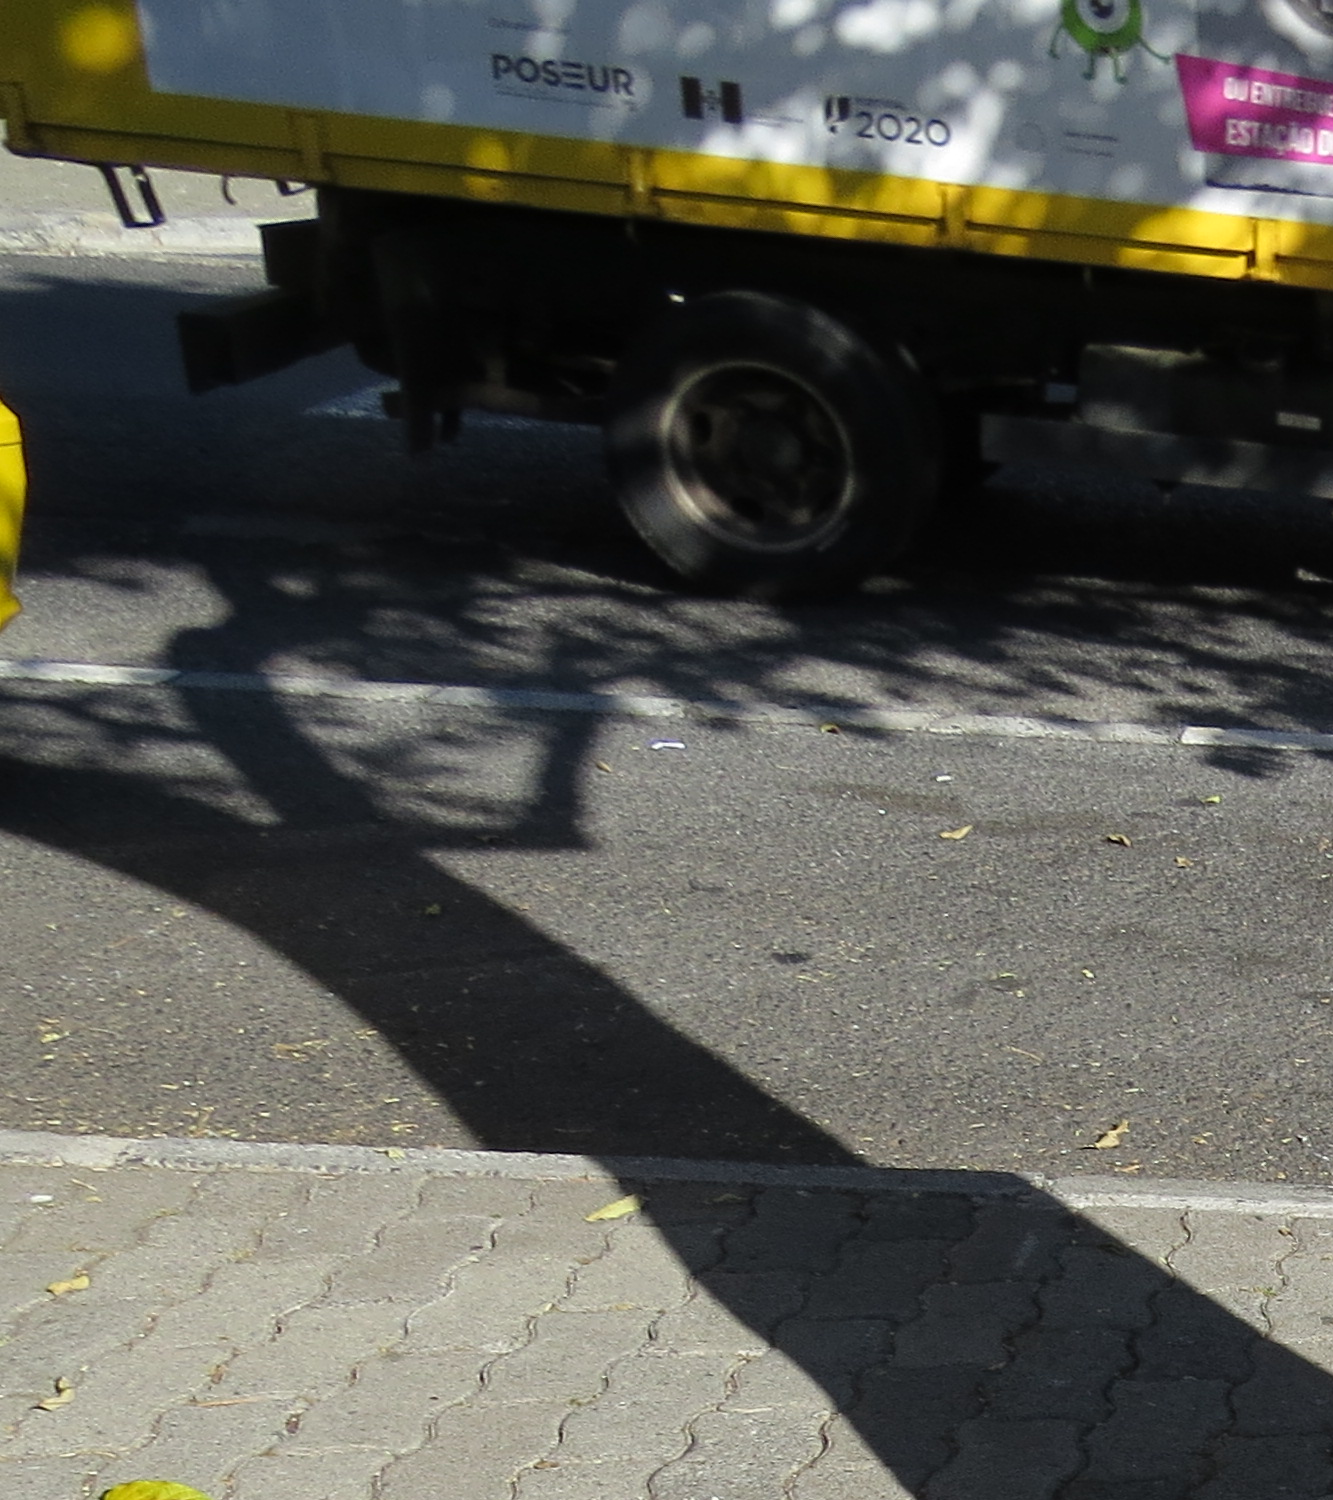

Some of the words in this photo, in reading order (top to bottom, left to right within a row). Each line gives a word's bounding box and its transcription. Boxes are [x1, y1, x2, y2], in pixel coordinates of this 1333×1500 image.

[492, 53, 635, 96] POSEUR
[856, 111, 951, 146] 2020
[1225, 117, 1314, 155] ESTAÇÃO
